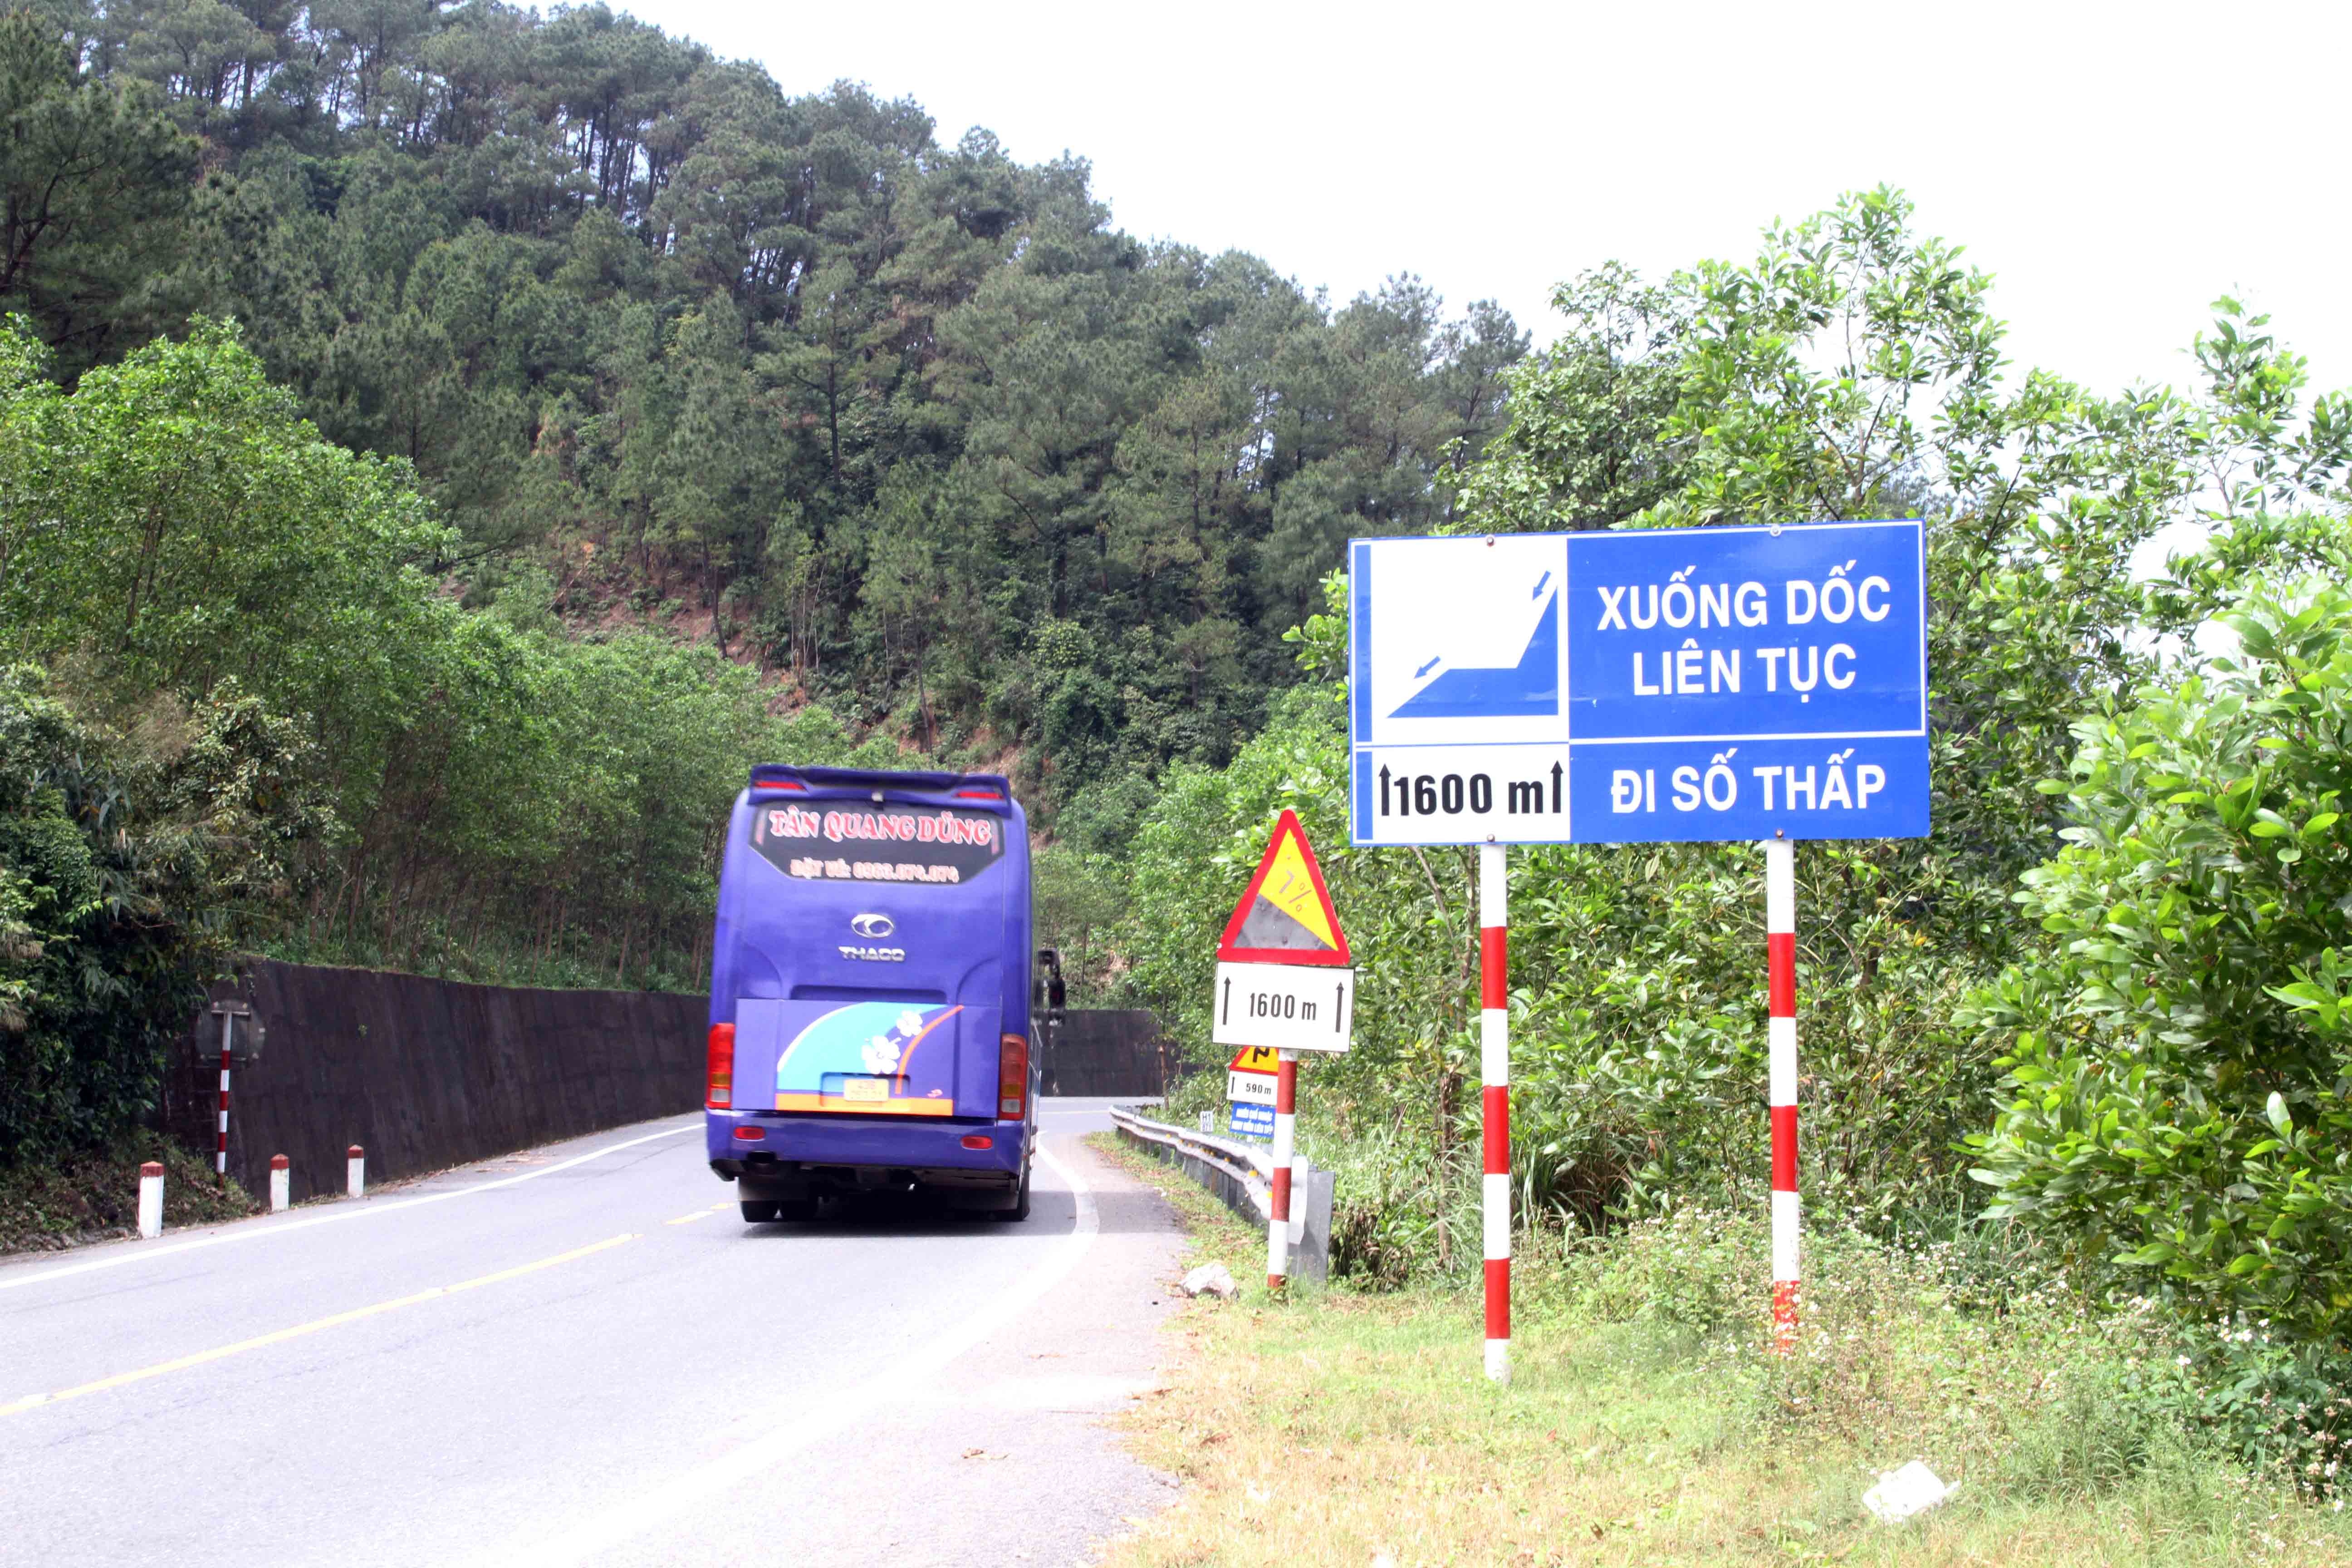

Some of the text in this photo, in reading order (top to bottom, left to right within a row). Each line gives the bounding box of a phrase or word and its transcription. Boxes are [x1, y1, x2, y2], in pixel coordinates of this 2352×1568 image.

[1597, 560, 1891, 630] XUỐNG DỐC
[1633, 638, 1857, 703] LIÊN TỤC
[1393, 773, 1543, 816] 1600 m
[1611, 747, 1886, 813] ĐI SỐ THẤP
[769, 805, 820, 838] TÂN
[824, 811, 916, 842] QUANG
[838, 946, 905, 961] THACO
[1250, 993, 1317, 1020] 1600 m
[1245, 1083, 1272, 1096] 590 m
